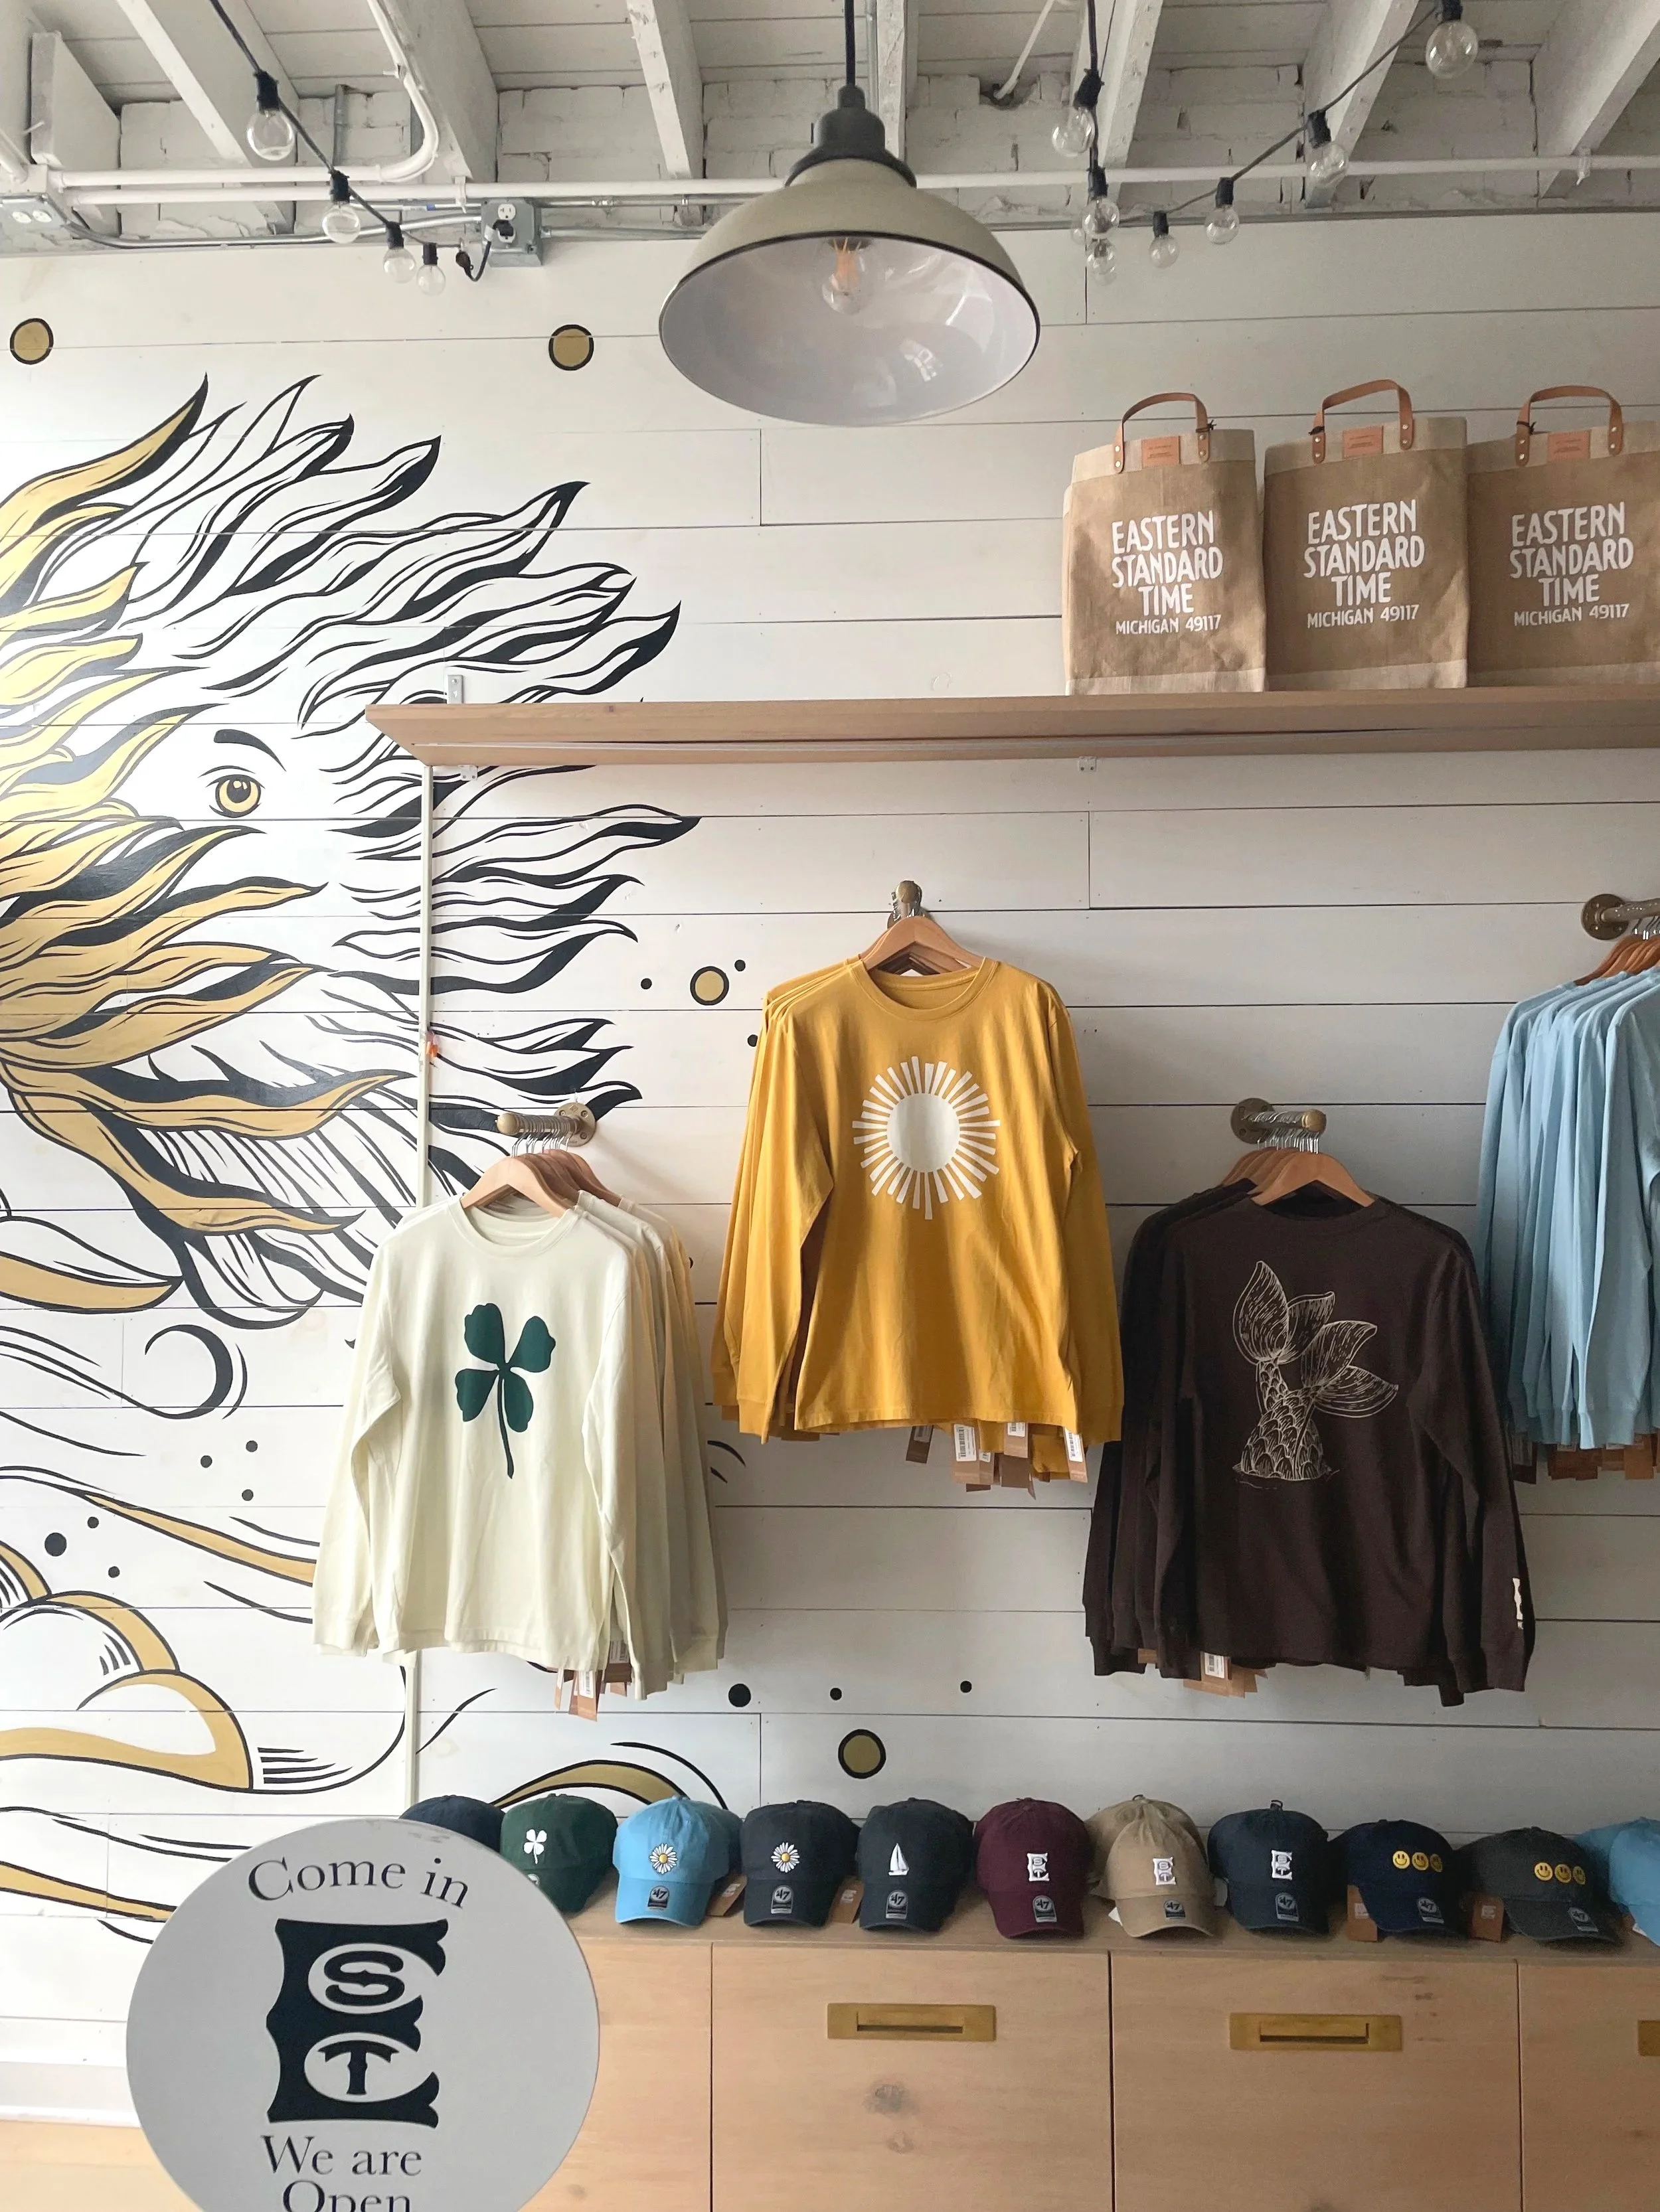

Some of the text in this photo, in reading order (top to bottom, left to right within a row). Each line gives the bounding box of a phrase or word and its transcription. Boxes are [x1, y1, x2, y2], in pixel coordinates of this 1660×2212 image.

[1112, 510, 1214, 554] EASTERN
[1307, 499, 1417, 545] EASTERN
[1511, 502, 1625, 547] EASTERN
[1111, 546, 1224, 588] STANDARD
[1303, 536, 1426, 579] STANDARD
[1509, 537, 1634, 579] STANDARD
[1137, 583, 1195, 617] TIME
[1330, 572, 1392, 607] TIME
[1538, 573, 1600, 606] TIME
[1116, 614, 1222, 635] MICHIGAN 49117
[1306, 604, 1420, 629] MICHIGAN 49117
[1513, 603, 1630, 626] MICHIGAN 49117
[248, 1857, 469, 1909] Come in
[260, 2134, 422, 2177] We are
